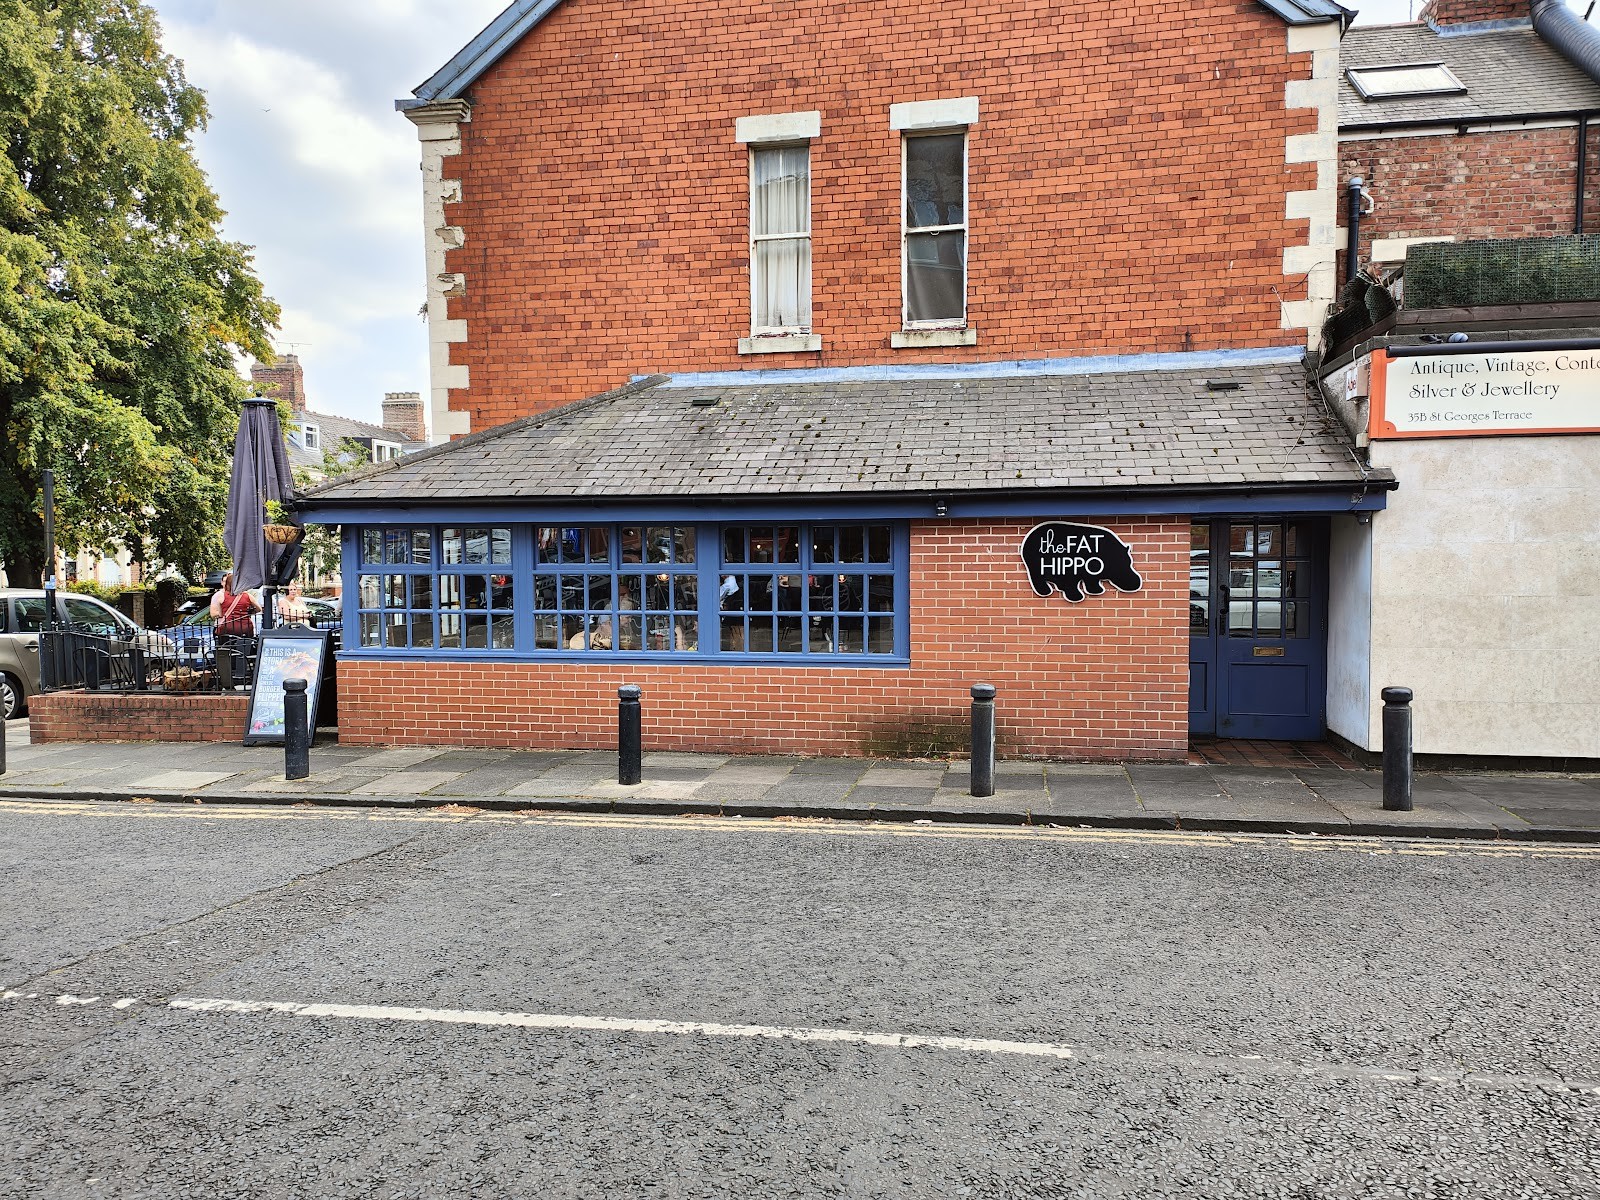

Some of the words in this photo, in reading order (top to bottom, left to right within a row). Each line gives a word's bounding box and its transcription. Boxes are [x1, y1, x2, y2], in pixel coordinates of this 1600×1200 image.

[1410, 360, 1479, 378] Antique,
[1485, 358, 1550, 376] Vintage,
[1409, 384, 1457, 399] Silver
[1461, 382, 1476, 397] &
[1480, 381, 1561, 400] Jewellery
[1407, 412, 1427, 422] 35B
[1429, 411, 1441, 421] St
[1444, 411, 1490, 424] Georges
[1492, 410, 1533, 420] Terrace
[1039, 529, 1067, 554] the
[1066, 535, 1105, 554] FAT
[1040, 557, 1105, 576] HIPPO
[263, 657, 284, 665] STORY
[270, 648, 284, 656] THIS
[285, 648, 291, 656] IS
